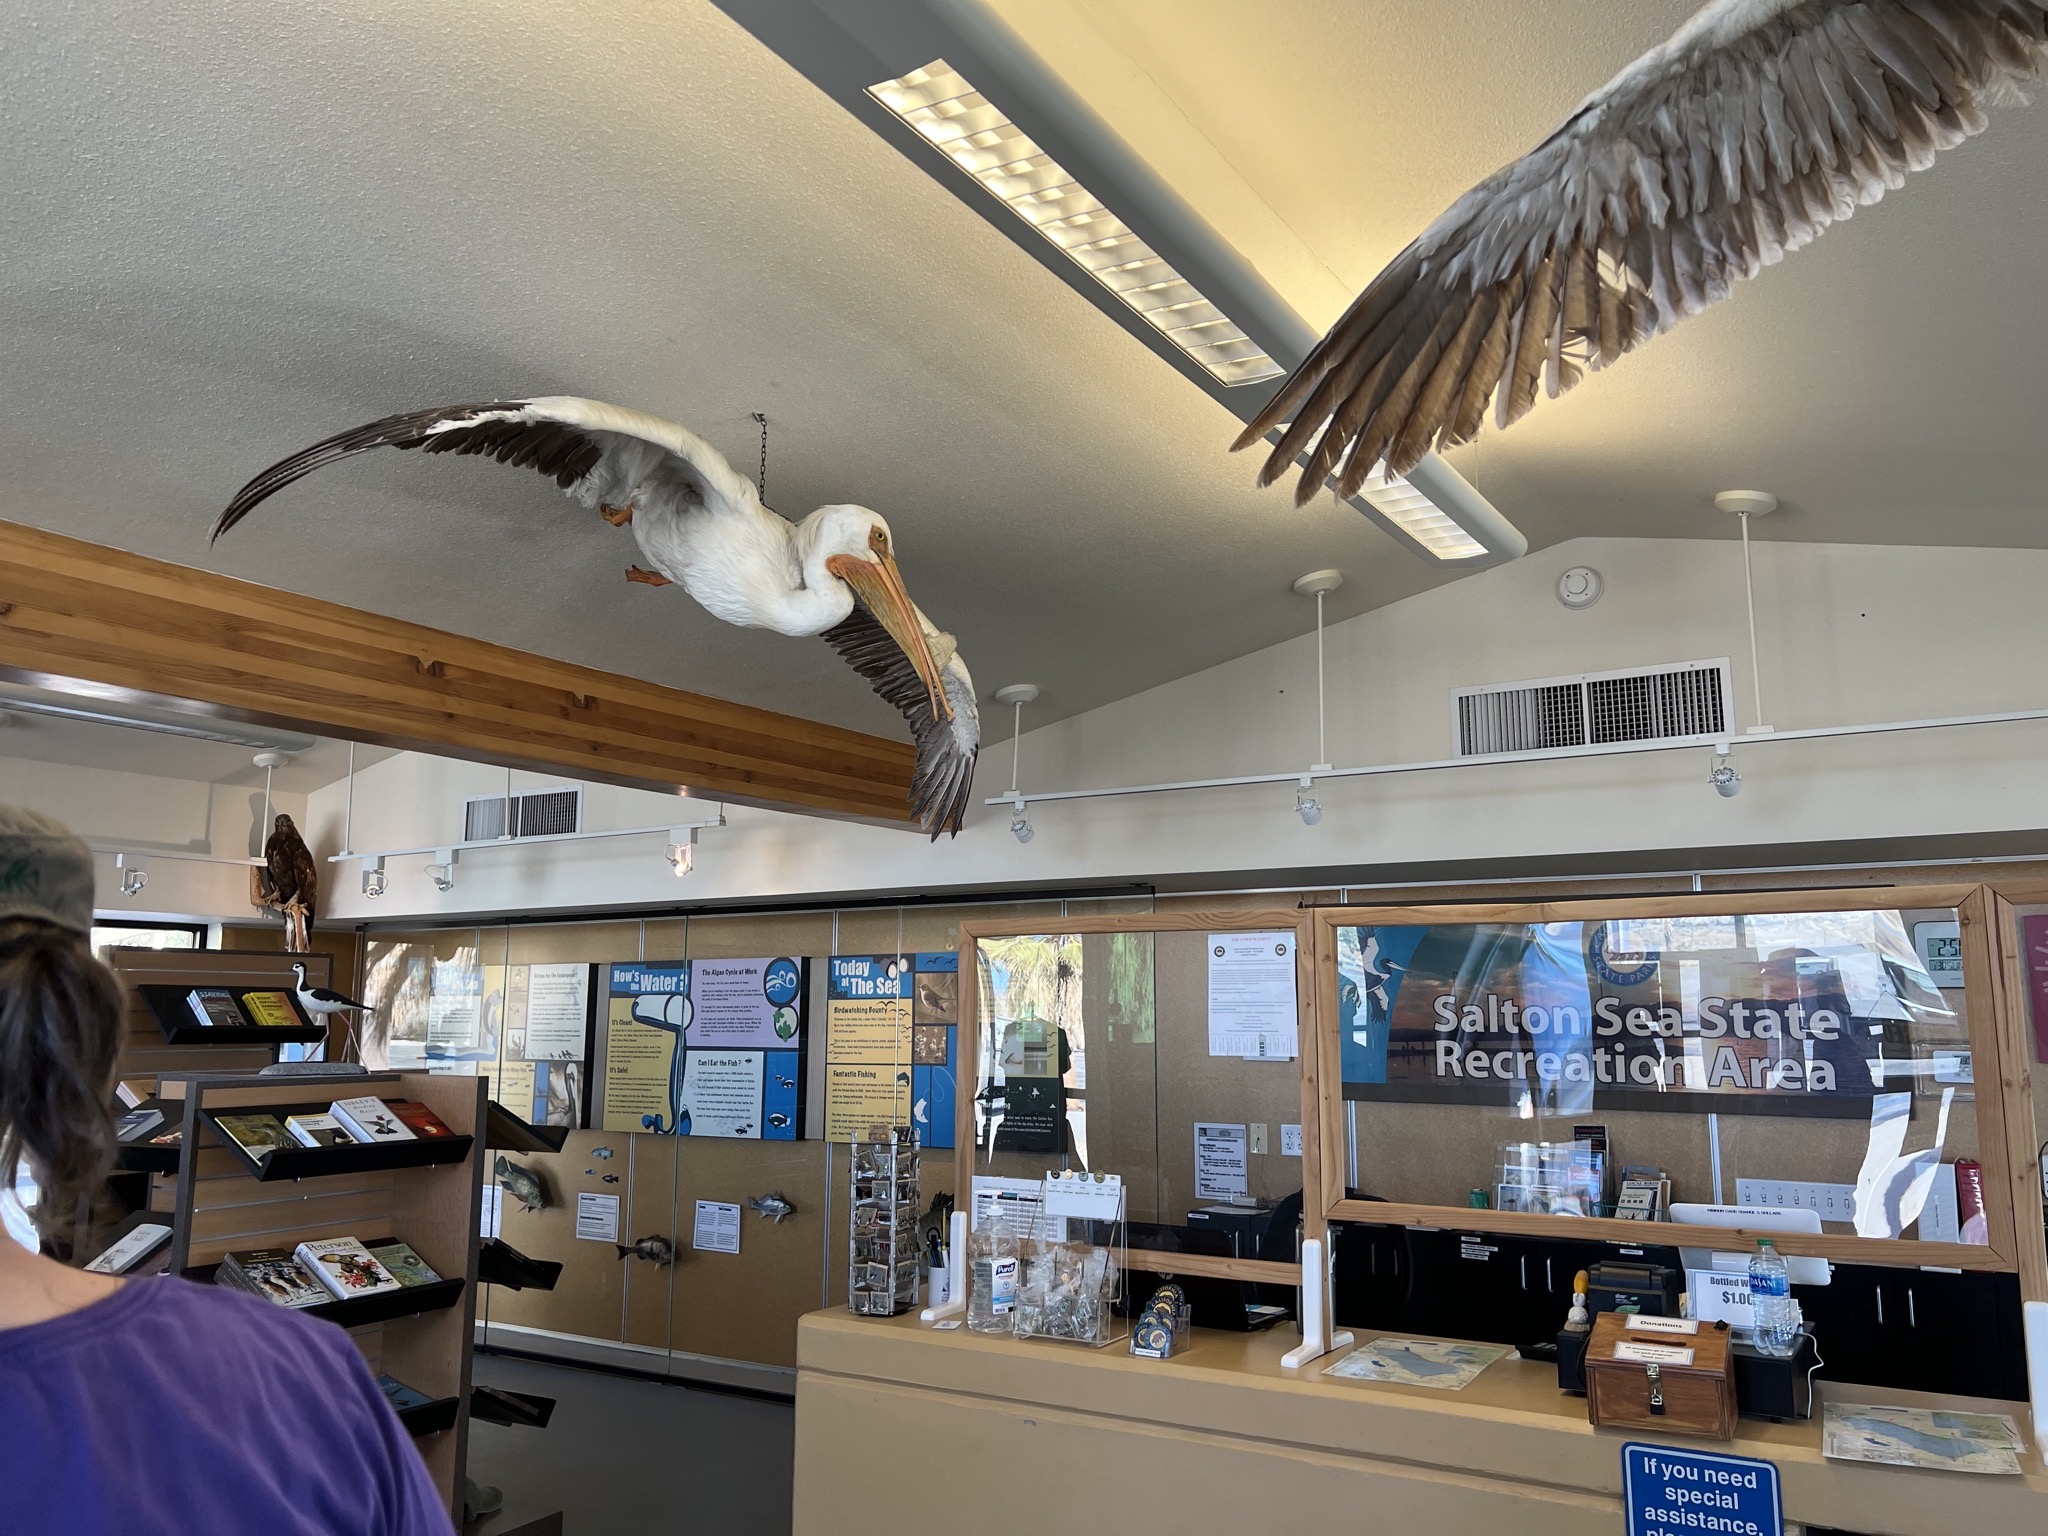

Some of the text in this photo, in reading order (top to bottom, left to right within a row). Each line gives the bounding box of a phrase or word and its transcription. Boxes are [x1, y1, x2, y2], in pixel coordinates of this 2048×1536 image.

[614, 970, 639, 982] How's
[711, 969, 725, 977] Algae
[725, 969, 738, 977] Cycle
[834, 960, 870, 977] Today
[1593, 956, 1623, 983] STATE
[640, 974, 677, 991] Water
[841, 977, 849, 986] at
[850, 977, 901, 994] The Sea
[834, 1006, 887, 1014] Birdwatching Bounty
[1433, 993, 1841, 1041] Salton Sea State
[1434, 1038, 1838, 1091] Recreation Area
[857, 1070, 876, 1079] Fishing
[305, 1241, 353, 1251] Peterson
[303, 1251, 320, 1271] Peterson
[1710, 1276, 1739, 1287] Bottled
[1750, 1277, 1776, 1288] DASANI
[1155, 1286, 1179, 1299] ALIFORNIA
[1151, 1298, 1176, 1316] CALIFORNIA
[1640, 1320, 1683, 1329] Donations
[1643, 1456, 1757, 1489] If you need
[1665, 1486, 1739, 1510] special
